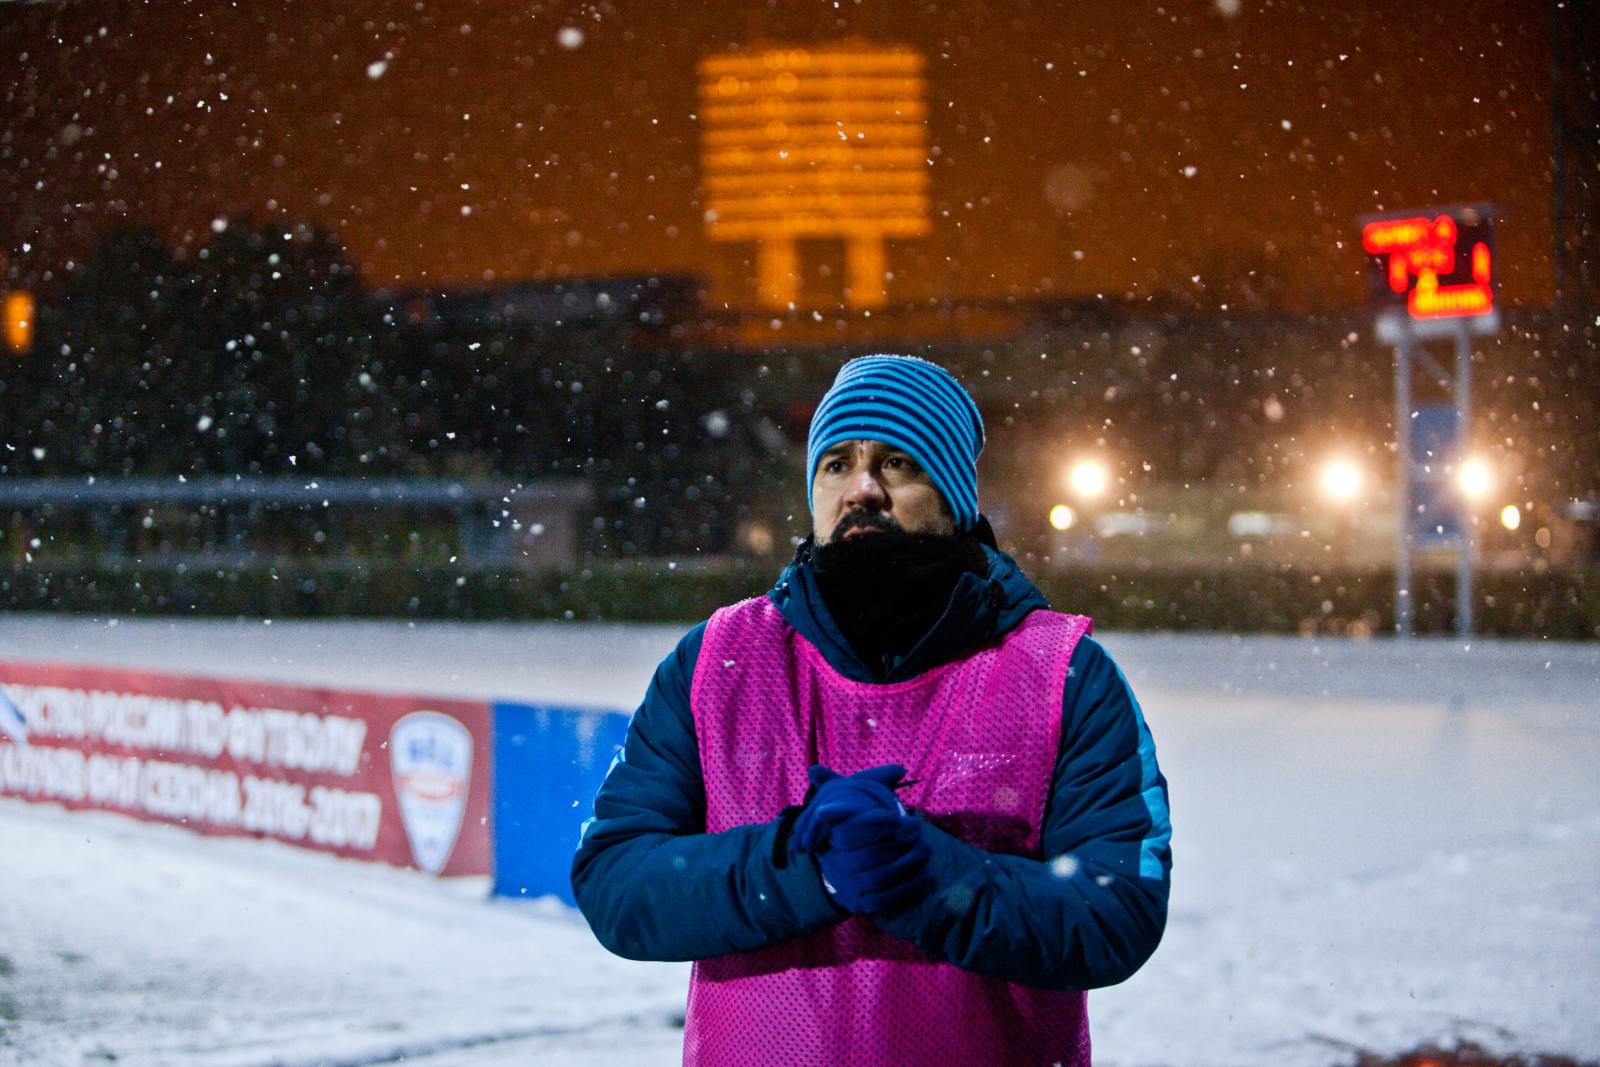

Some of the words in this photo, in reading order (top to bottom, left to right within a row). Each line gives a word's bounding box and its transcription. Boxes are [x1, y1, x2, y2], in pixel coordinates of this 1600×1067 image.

[88, 689, 184, 752] РОССИИ
[186, 698, 226, 758] ПО
[227, 703, 367, 777] ФУТБОЛУ
[143, 759, 241, 826] СЕЗОНА
[243, 774, 382, 850] 2016-2017
